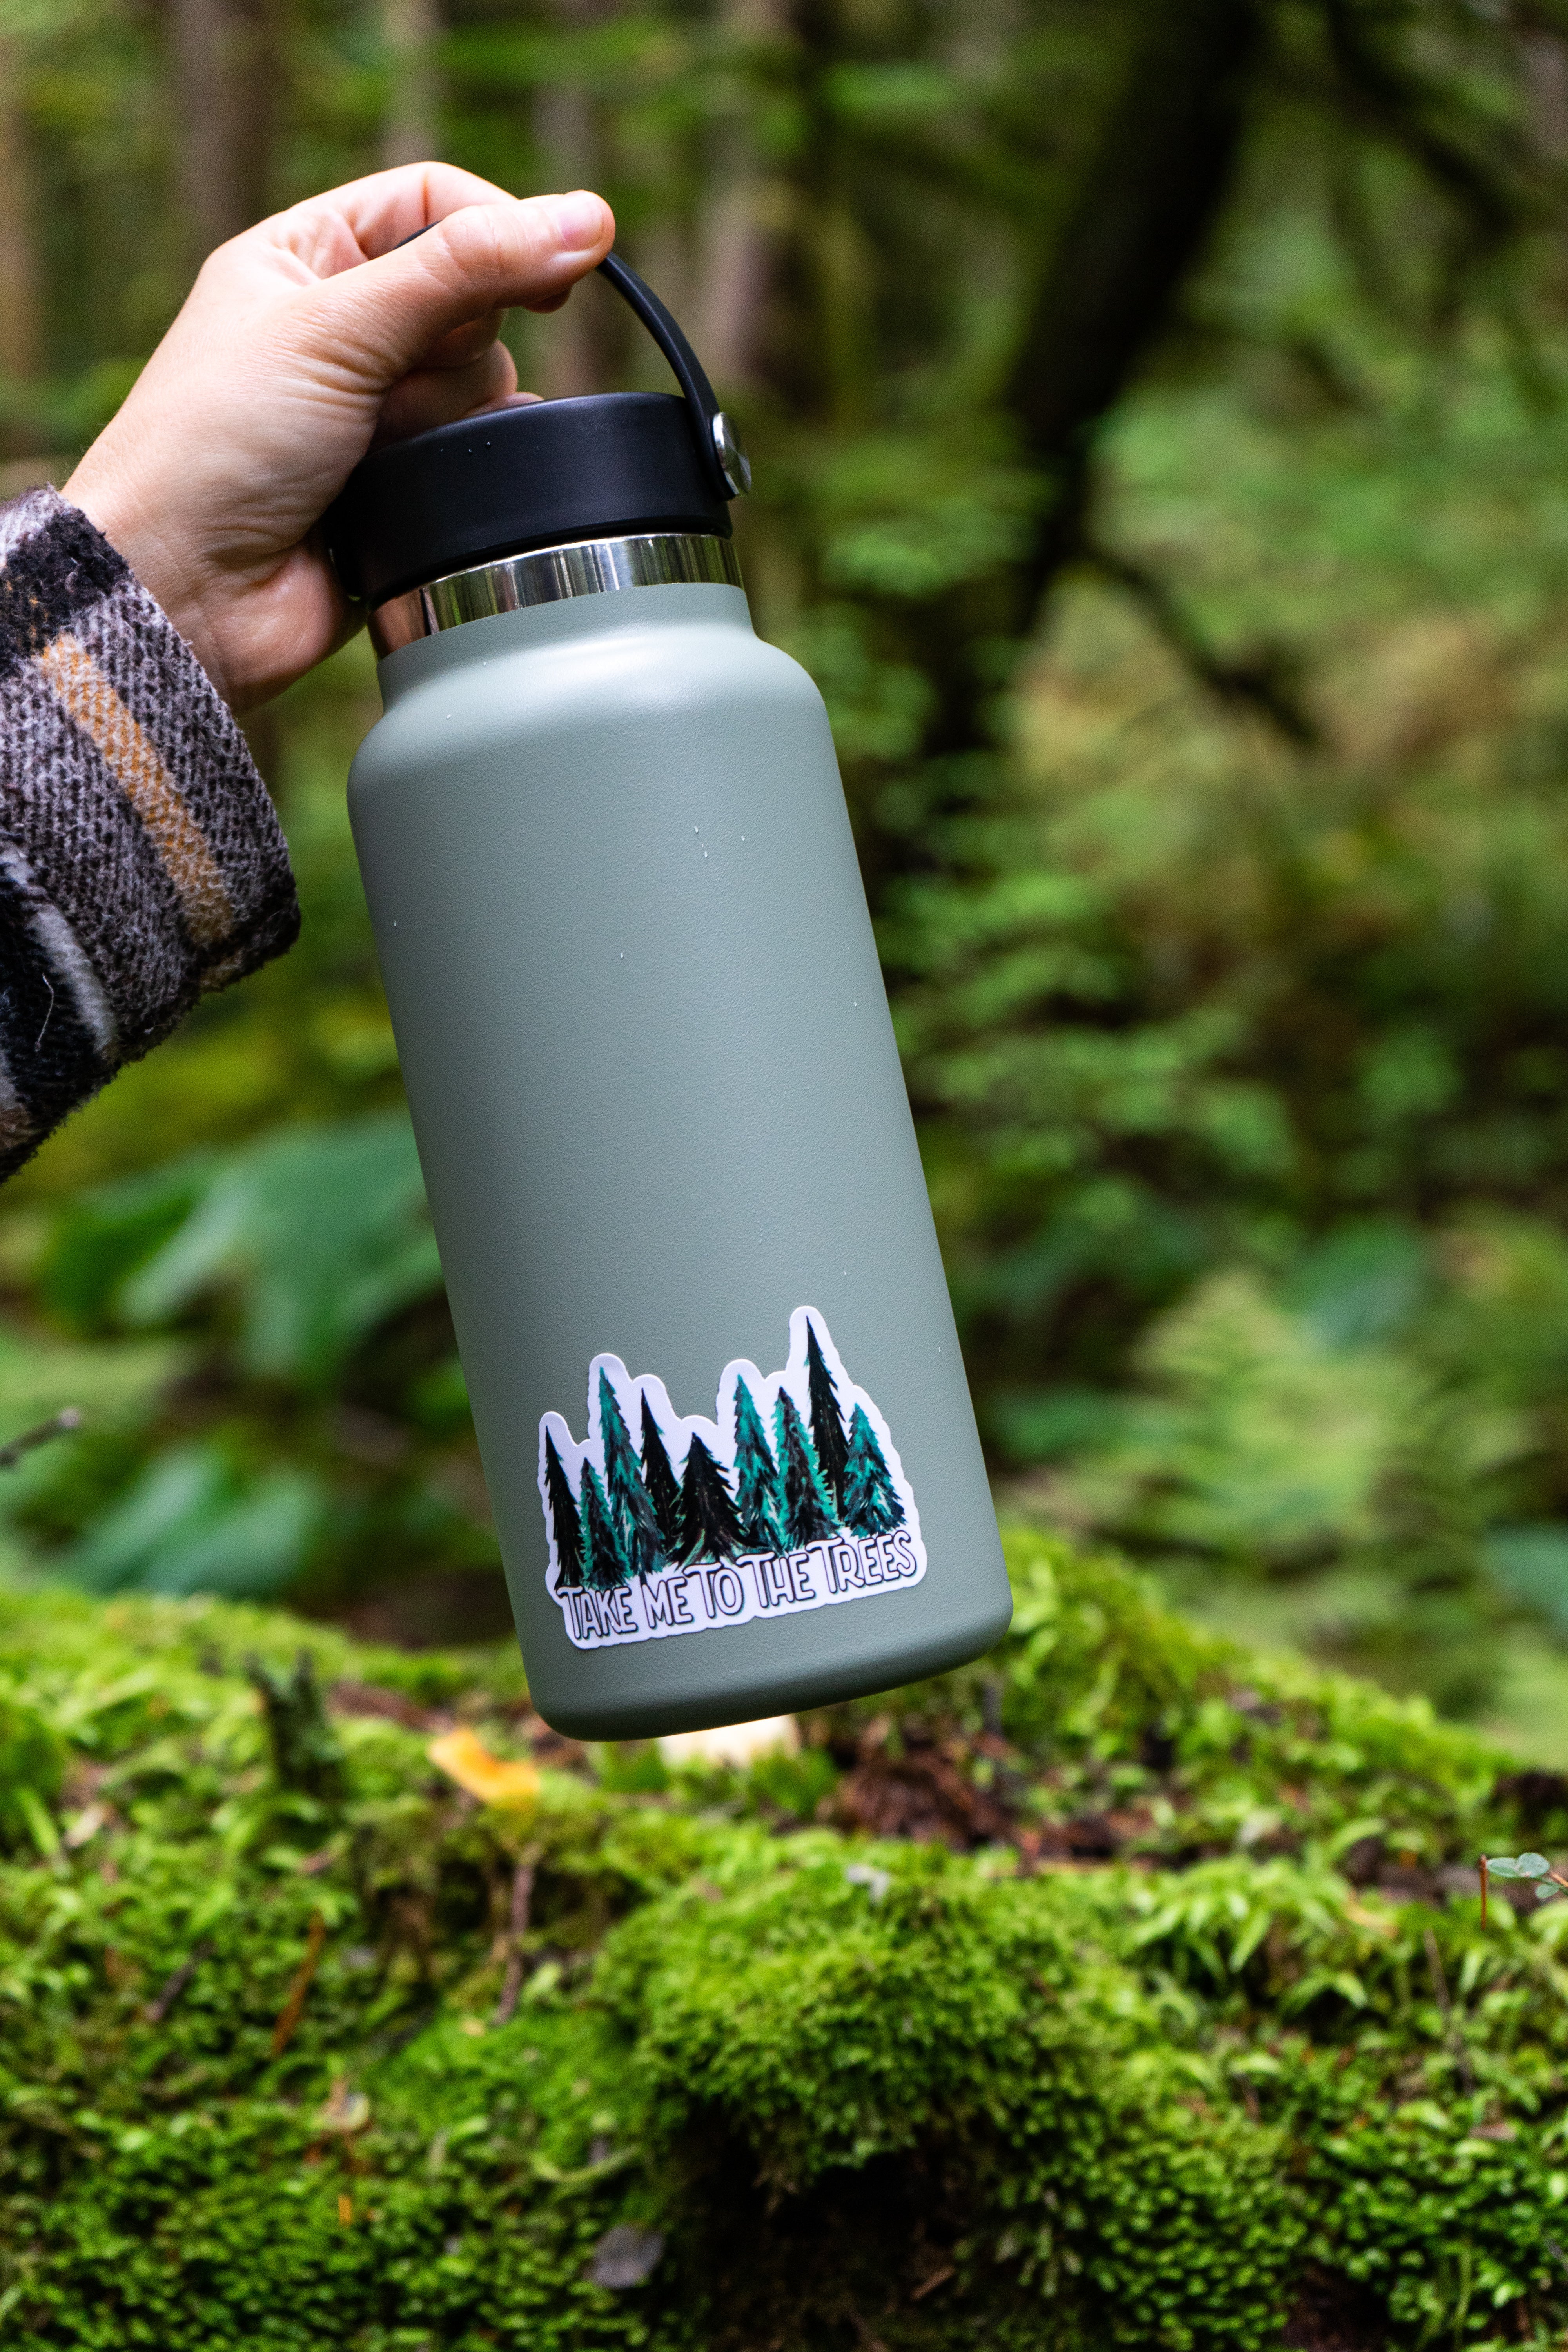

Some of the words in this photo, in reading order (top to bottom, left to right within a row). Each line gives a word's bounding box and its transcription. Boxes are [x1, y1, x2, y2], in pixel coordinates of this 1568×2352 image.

[557, 1586, 638, 1639] TAKE
[642, 1577, 695, 1628] ME
[682, 1562, 744, 1619] TO
[736, 1551, 815, 1608] THE
[805, 1530, 916, 1593] TREES
